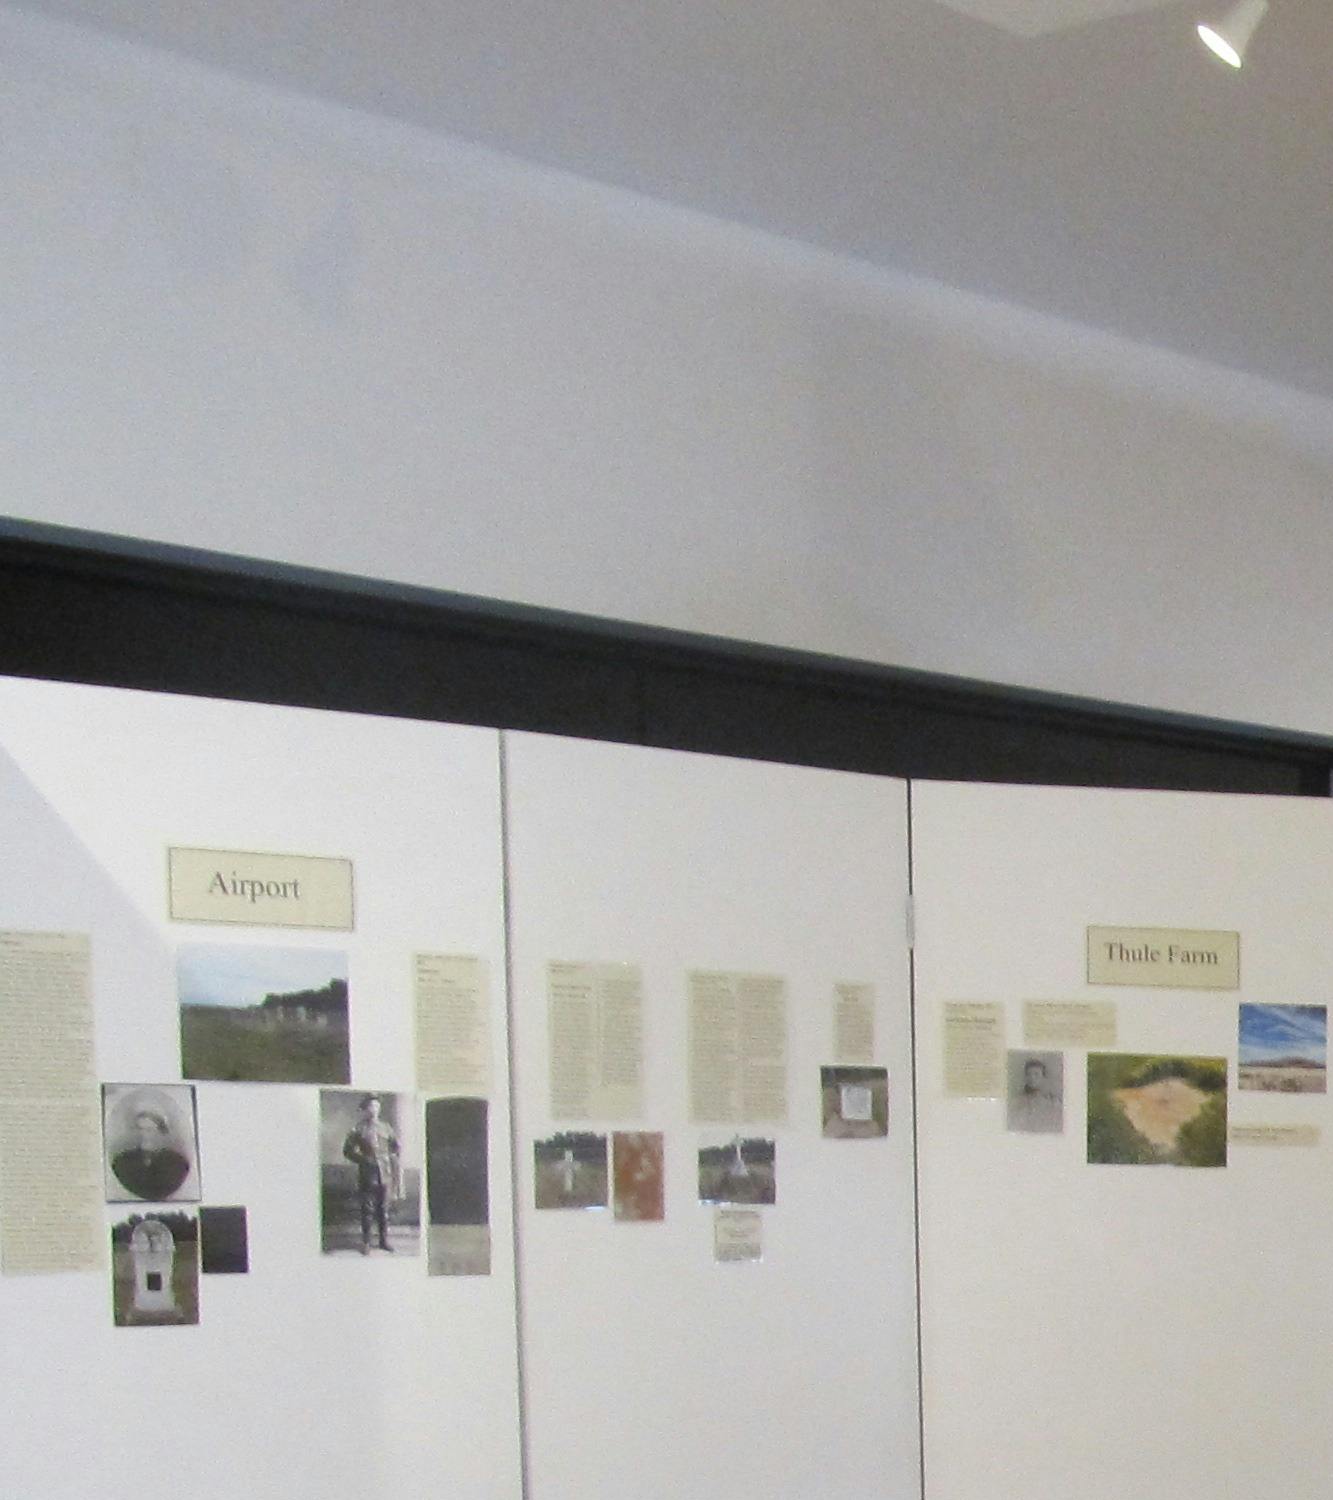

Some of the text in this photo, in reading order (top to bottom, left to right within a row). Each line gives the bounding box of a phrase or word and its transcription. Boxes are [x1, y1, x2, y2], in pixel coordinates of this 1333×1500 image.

[208, 870, 301, 904] Airport
[1103, 942, 1219, 965] Thule Farm
